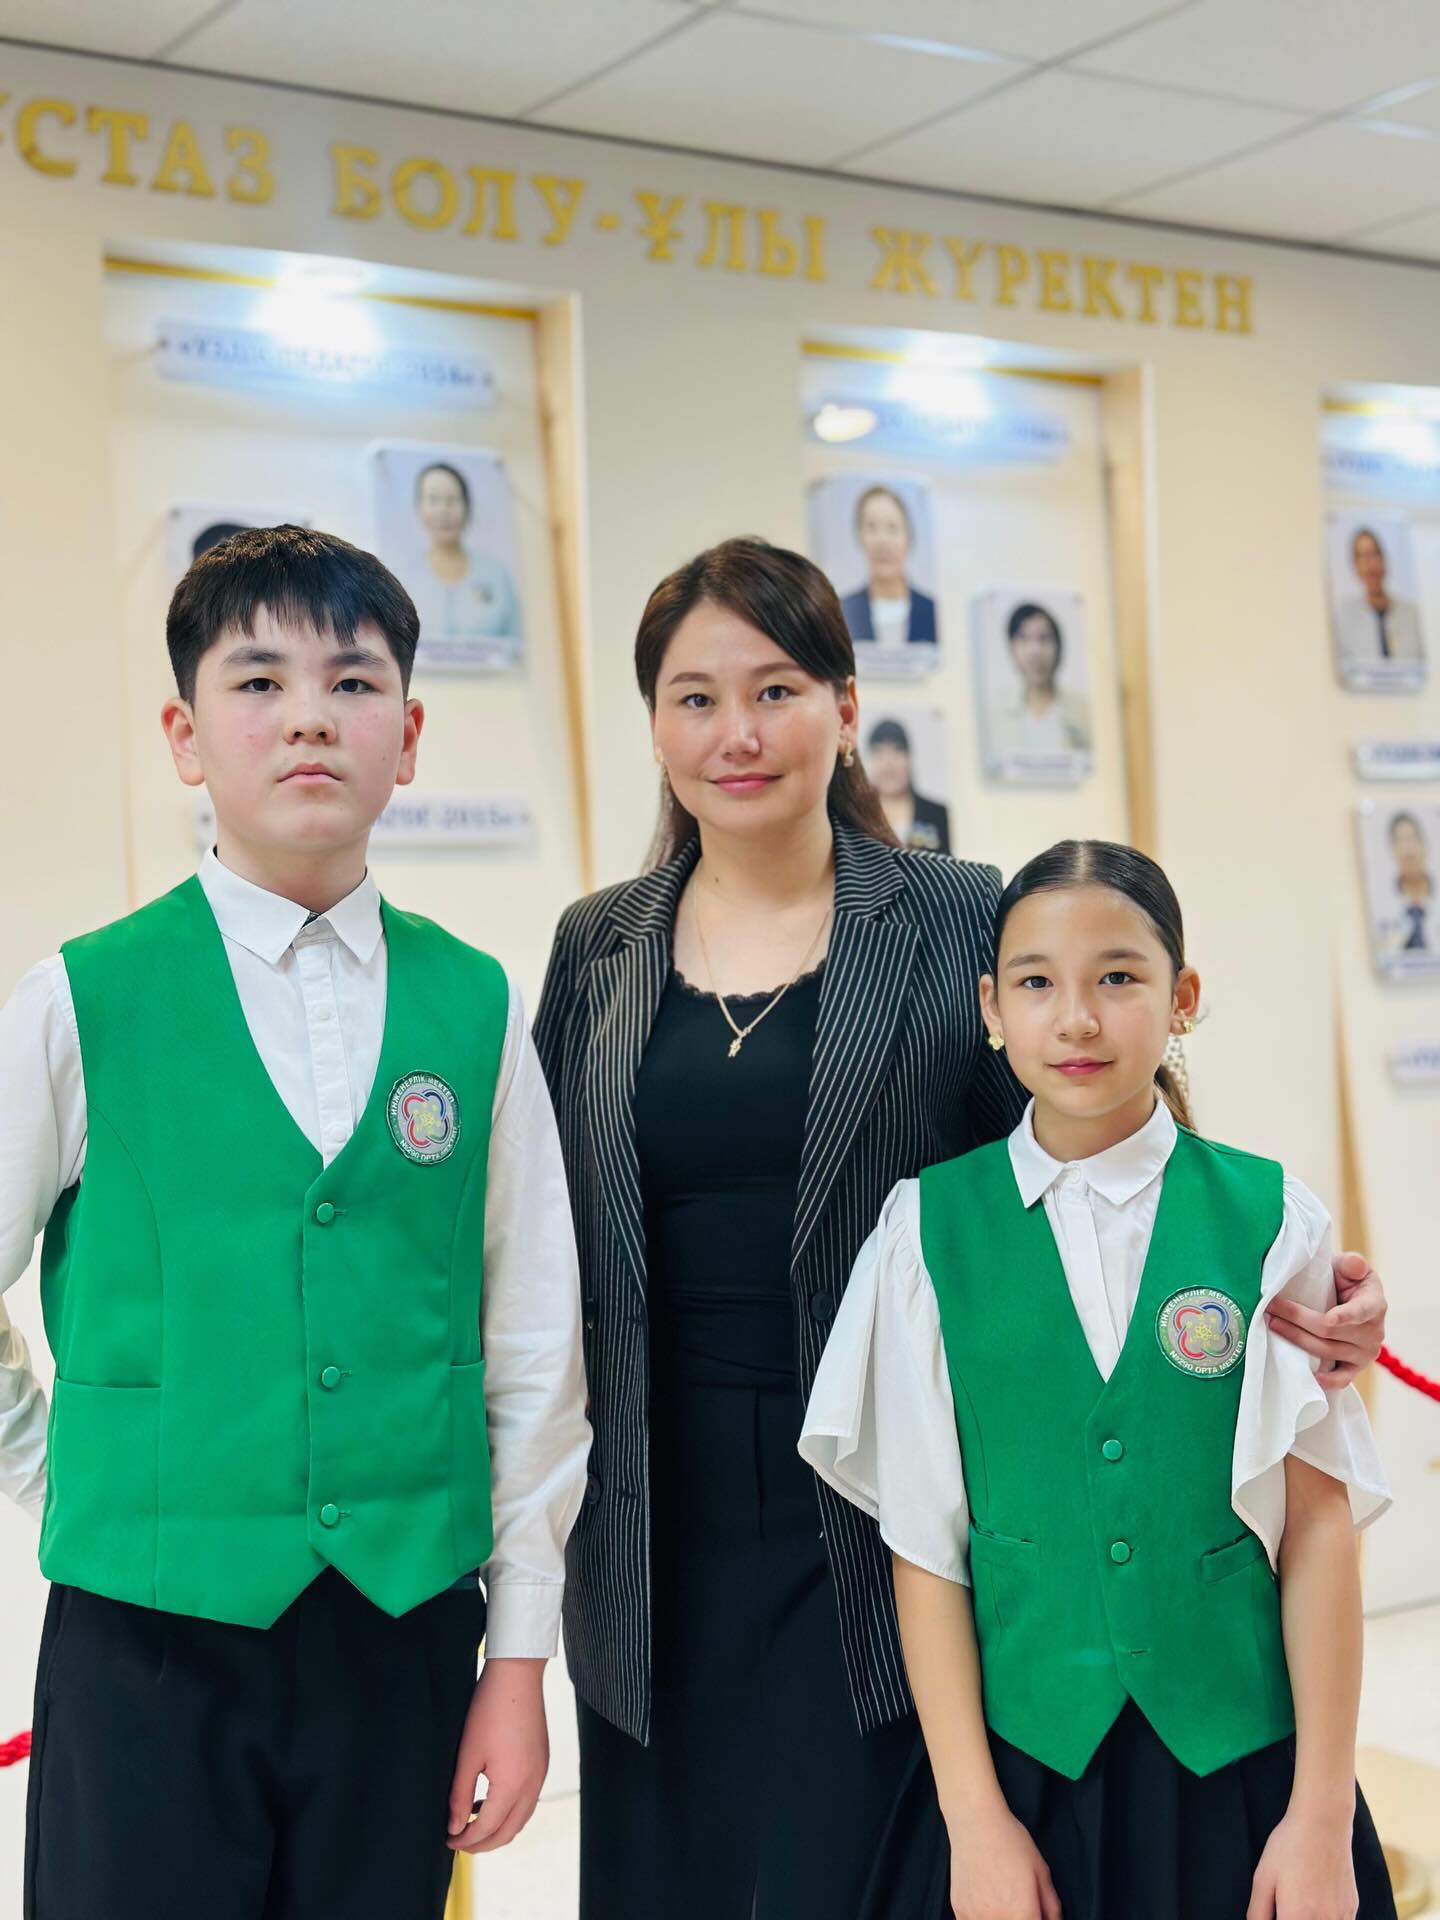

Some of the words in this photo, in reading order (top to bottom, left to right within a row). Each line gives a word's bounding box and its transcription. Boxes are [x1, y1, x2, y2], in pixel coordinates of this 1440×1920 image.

[0, 90, 274, 205] СТАЗ
[870, 225, 1254, 336] ЖҮРЕКТЕН
[428, 1077, 455, 1103] МЕКТЕП
[1160, 1289, 1207, 1327] ИНЖЕНЕРЛІК
[1208, 1290, 1241, 1317] МЕКТЕП
[1195, 1366, 1218, 1374] ОРТА
[1219, 1340, 1244, 1370] МЕКТЕП
